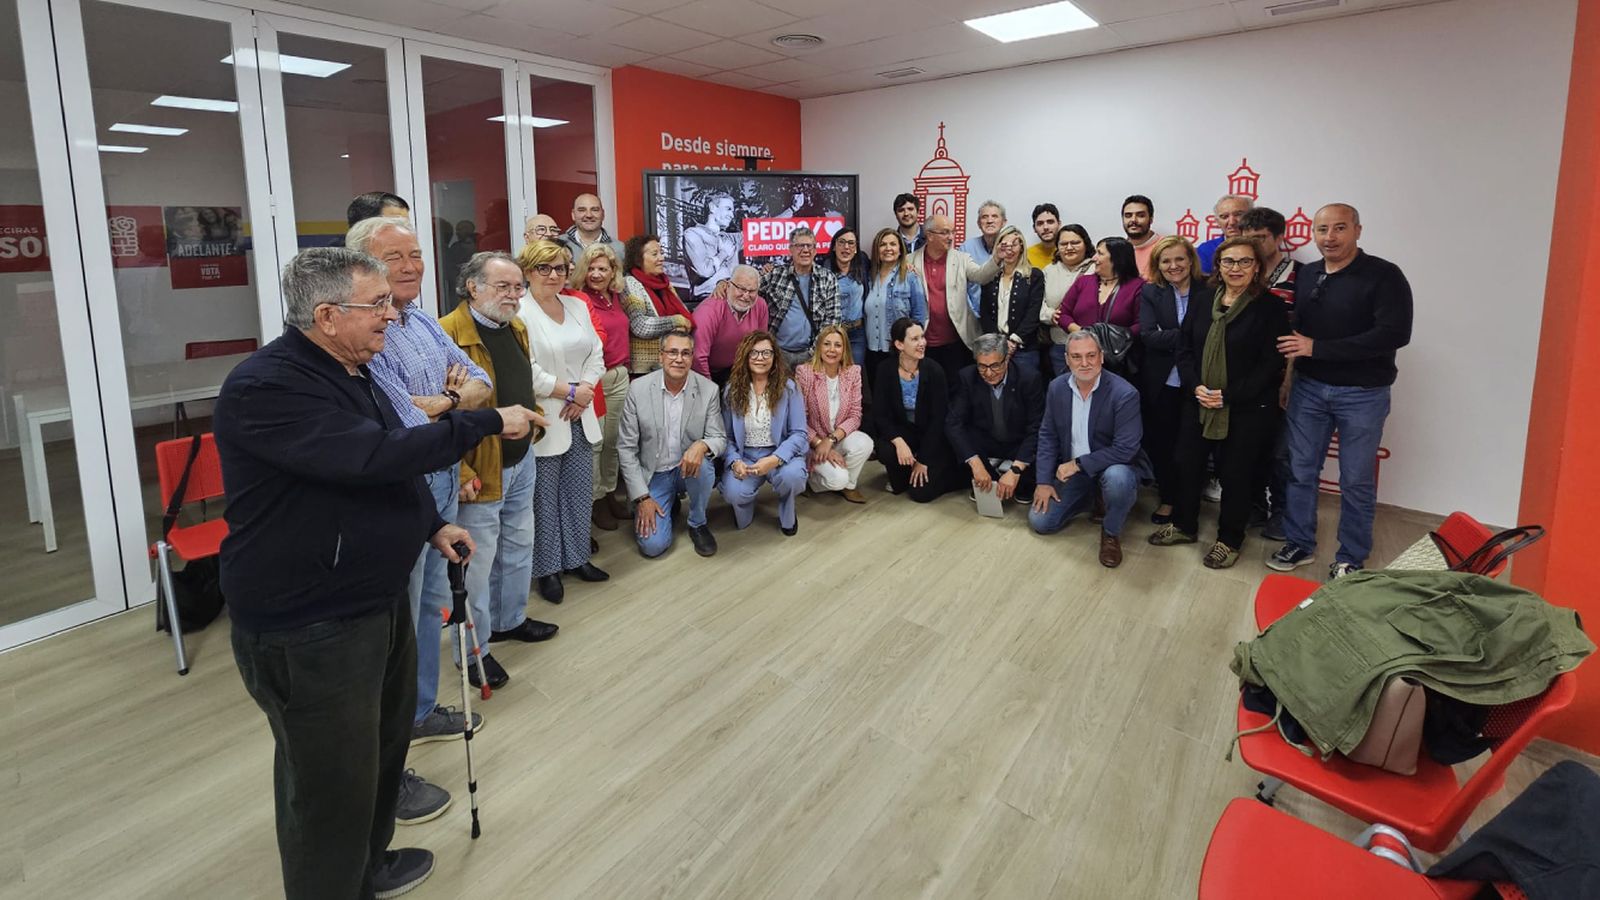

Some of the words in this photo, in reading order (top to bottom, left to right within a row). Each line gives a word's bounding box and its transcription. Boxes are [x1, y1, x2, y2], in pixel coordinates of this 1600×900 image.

[661, 132, 711, 154] Desde
[178, 242, 232, 257] ADELANTE
[748, 243, 774, 251] CLARO
